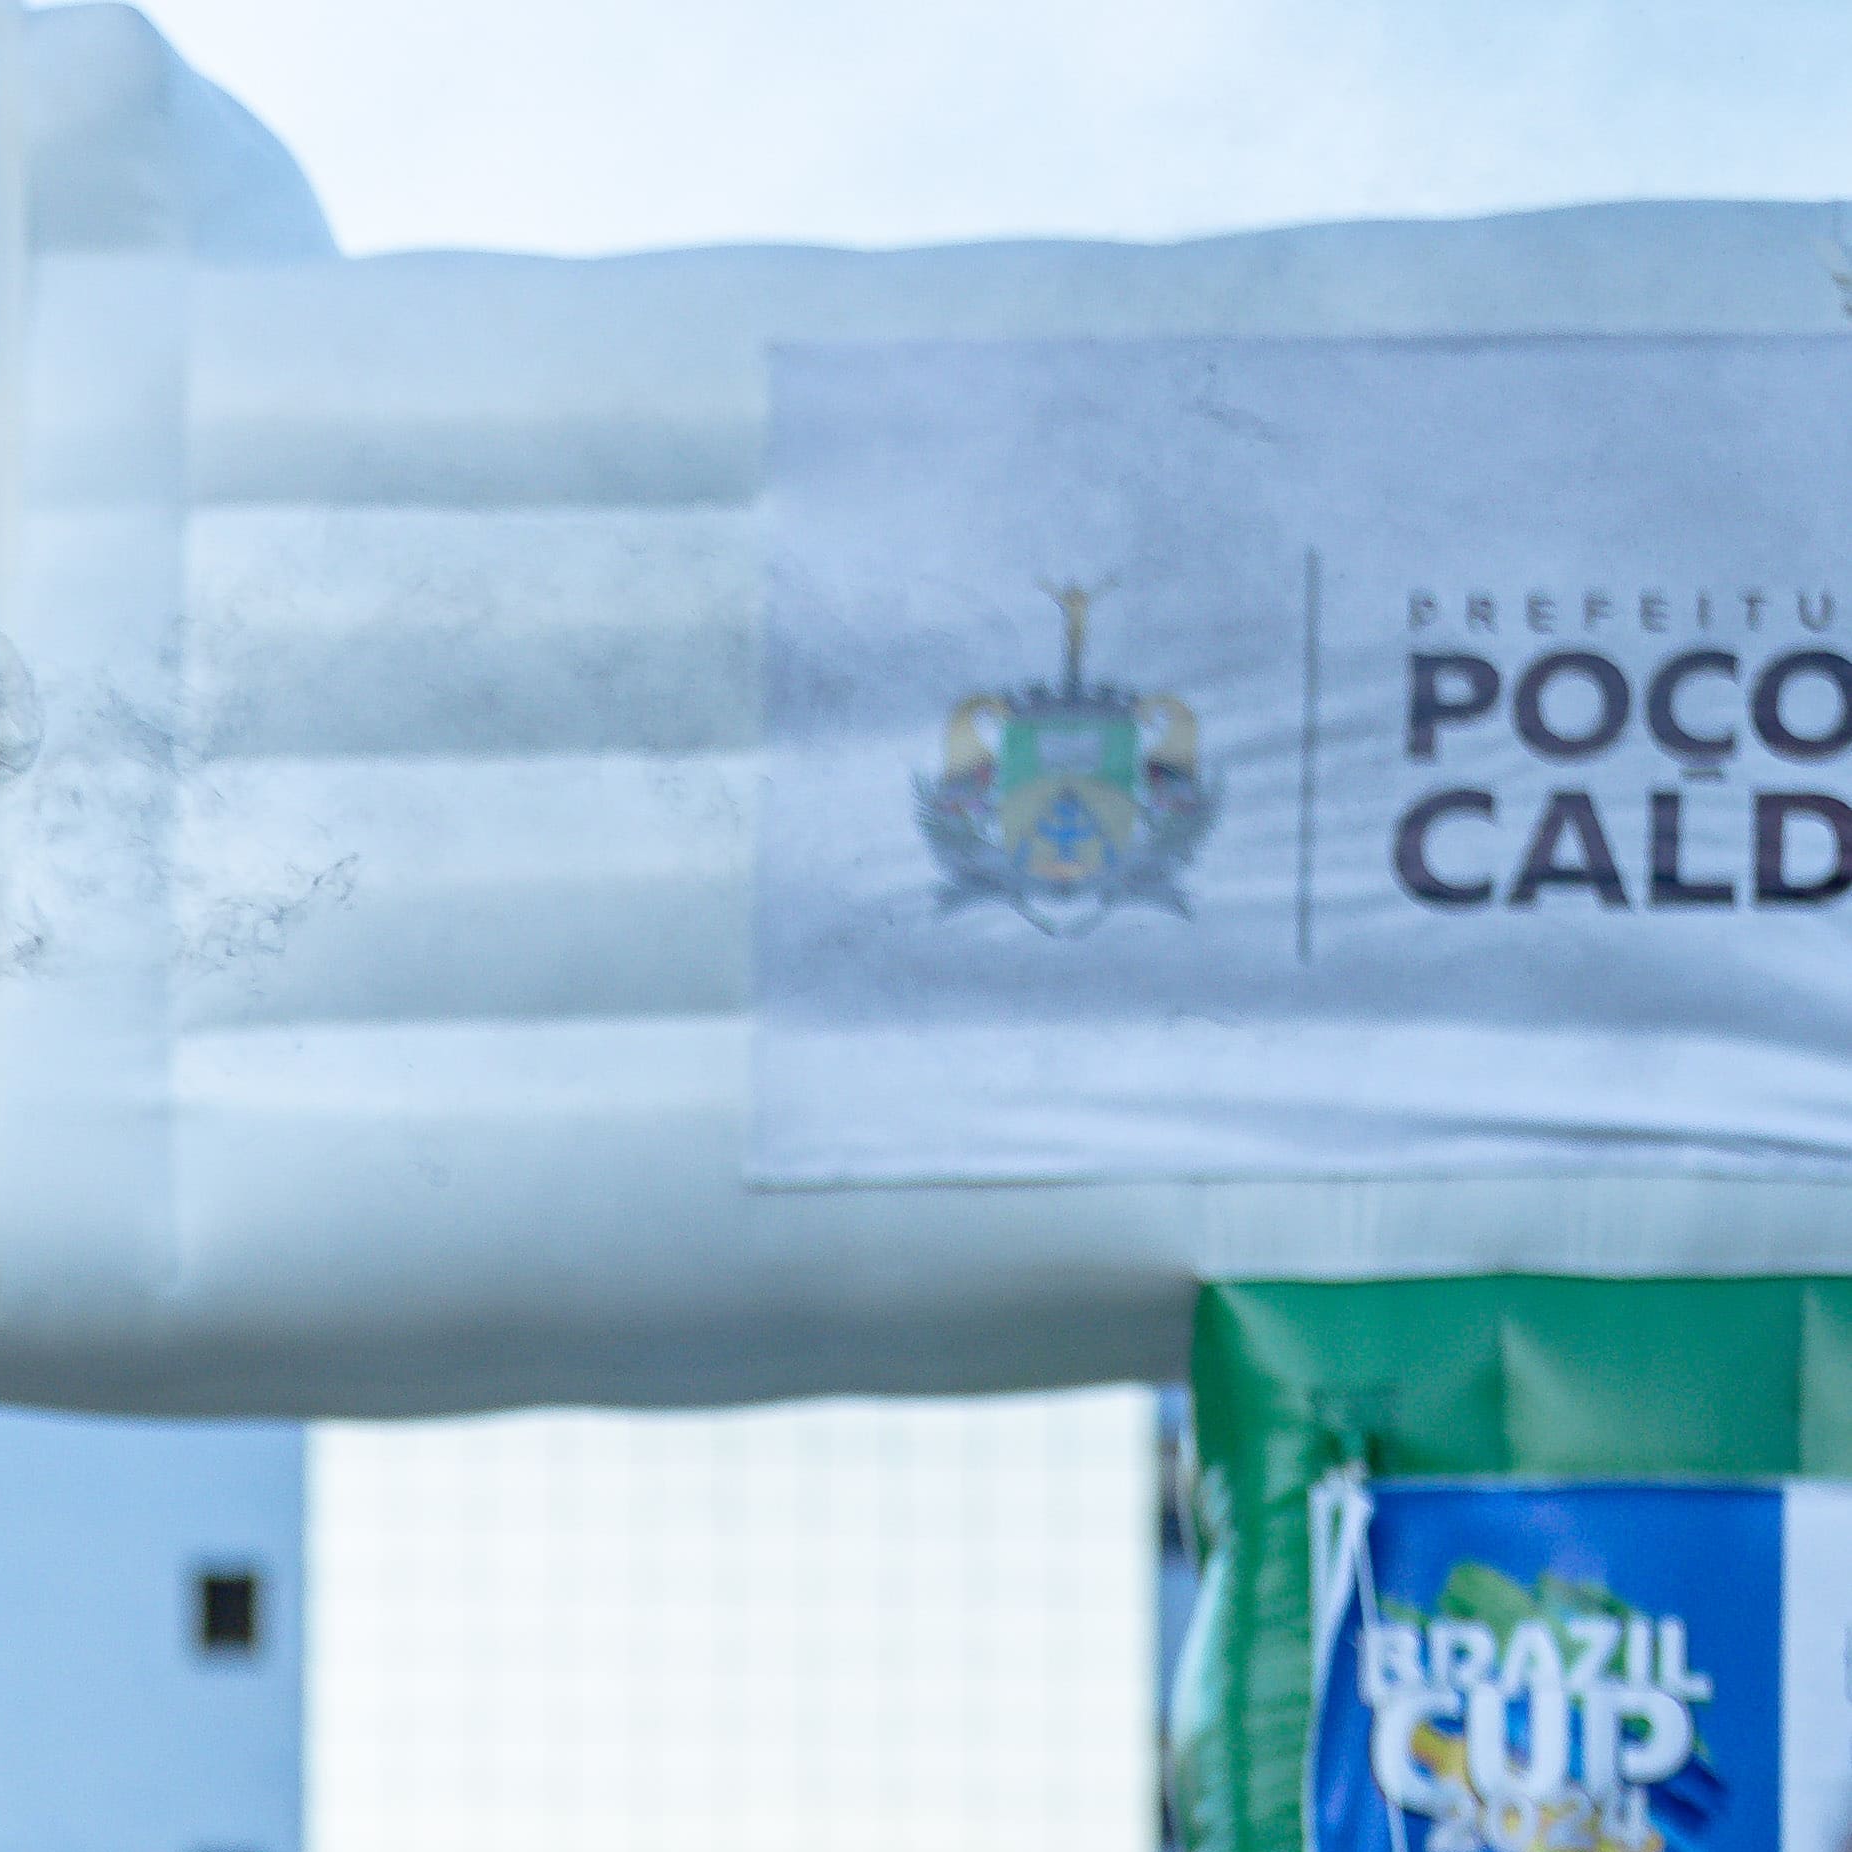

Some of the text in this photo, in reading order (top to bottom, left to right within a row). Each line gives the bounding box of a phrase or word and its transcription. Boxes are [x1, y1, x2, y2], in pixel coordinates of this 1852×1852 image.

[1407, 587, 1837, 634] PREFEITU
[1405, 646, 1852, 781] POÇO
[1391, 788, 1852, 912] CALD
[1360, 1615, 1712, 1706] BRAZIL
[1372, 1686, 1691, 1812] CUP
